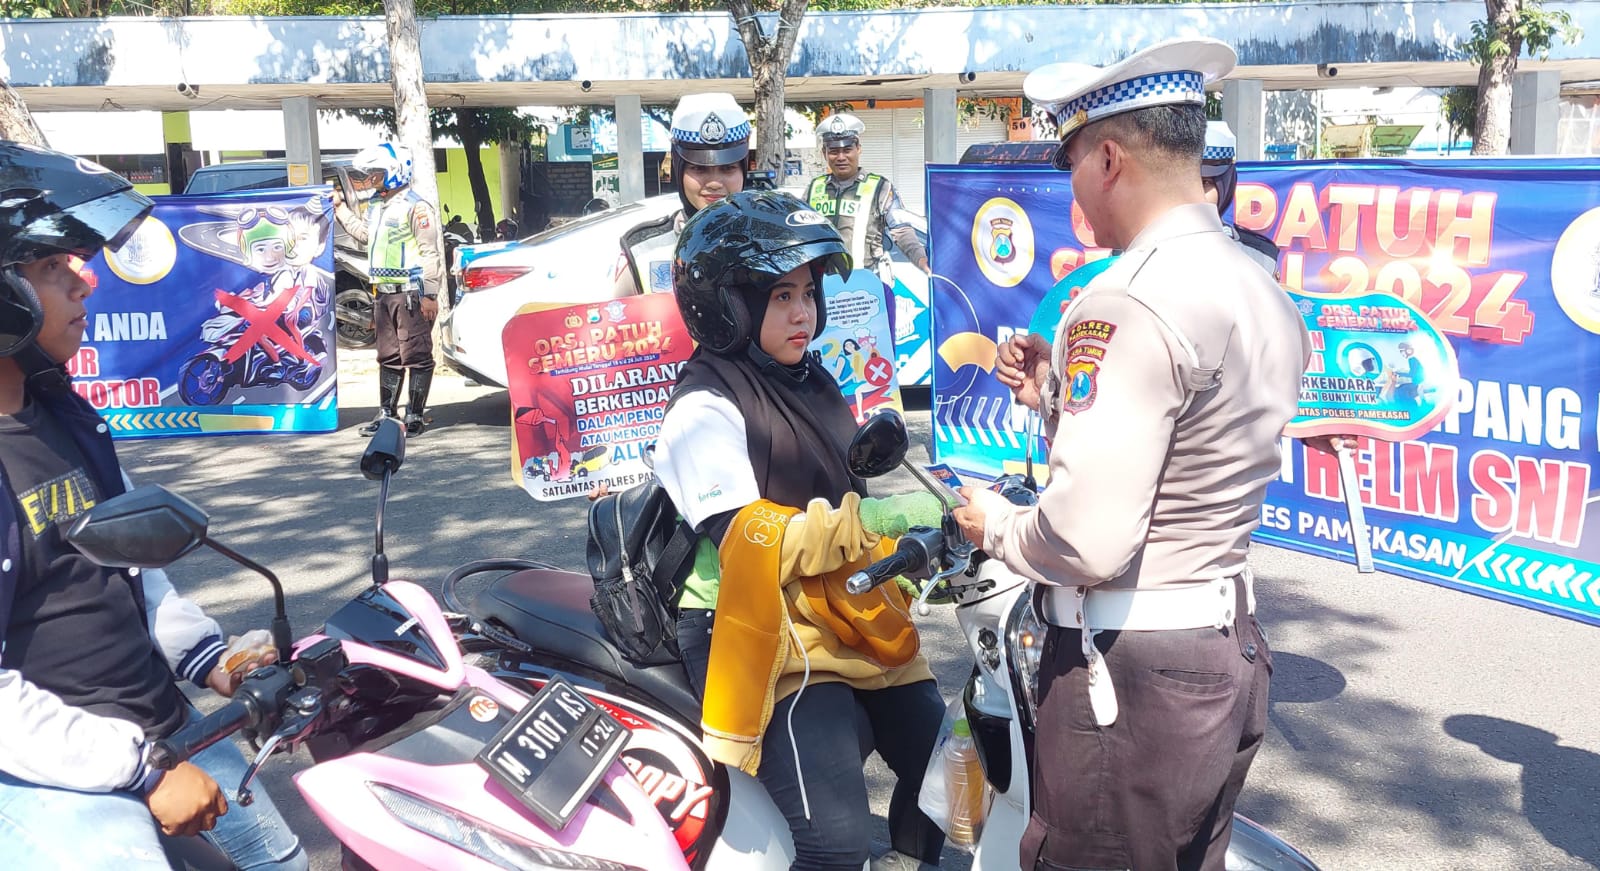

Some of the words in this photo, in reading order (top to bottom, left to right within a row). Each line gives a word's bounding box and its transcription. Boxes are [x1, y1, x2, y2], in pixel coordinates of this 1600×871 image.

[1012, 121, 1026, 131] 50
[1233, 182, 1497, 266] PATUH
[1325, 255, 1535, 346] 2024
[1359, 305, 1411, 320] PATUH
[94, 312, 168, 342] ANDA
[1071, 321, 1111, 335] POLRES
[1317, 315, 1377, 328] SEMERU
[534, 333, 585, 355] OPS.
[590, 321, 663, 345] PATUH
[528, 342, 616, 374] SEMERU
[621, 336, 674, 357] 2024
[574, 385, 675, 417] BERKENDA
[1322, 392, 1351, 402] BUNYI
[1355, 393, 1377, 403] KLIK
[577, 411, 627, 432] DALAM
[627, 407, 663, 424] PENG
[1323, 408, 1356, 418] POLRES
[1358, 409, 1410, 420] PAMEKASAN
[1433, 378, 1582, 450] PANG
[580, 431, 611, 447] ATAU
[613, 425, 661, 442] MENGON
[542, 480, 595, 498] SATLANTAS
[598, 474, 635, 488] POLRES
[638, 471, 657, 487] PAM
[1304, 436, 1459, 523] HELM
[1469, 449, 1591, 548] SNI
[1259, 503, 1291, 531] ES
[497, 750, 532, 784] M
[518, 711, 568, 760] 3107
[555, 691, 587, 721] AS
